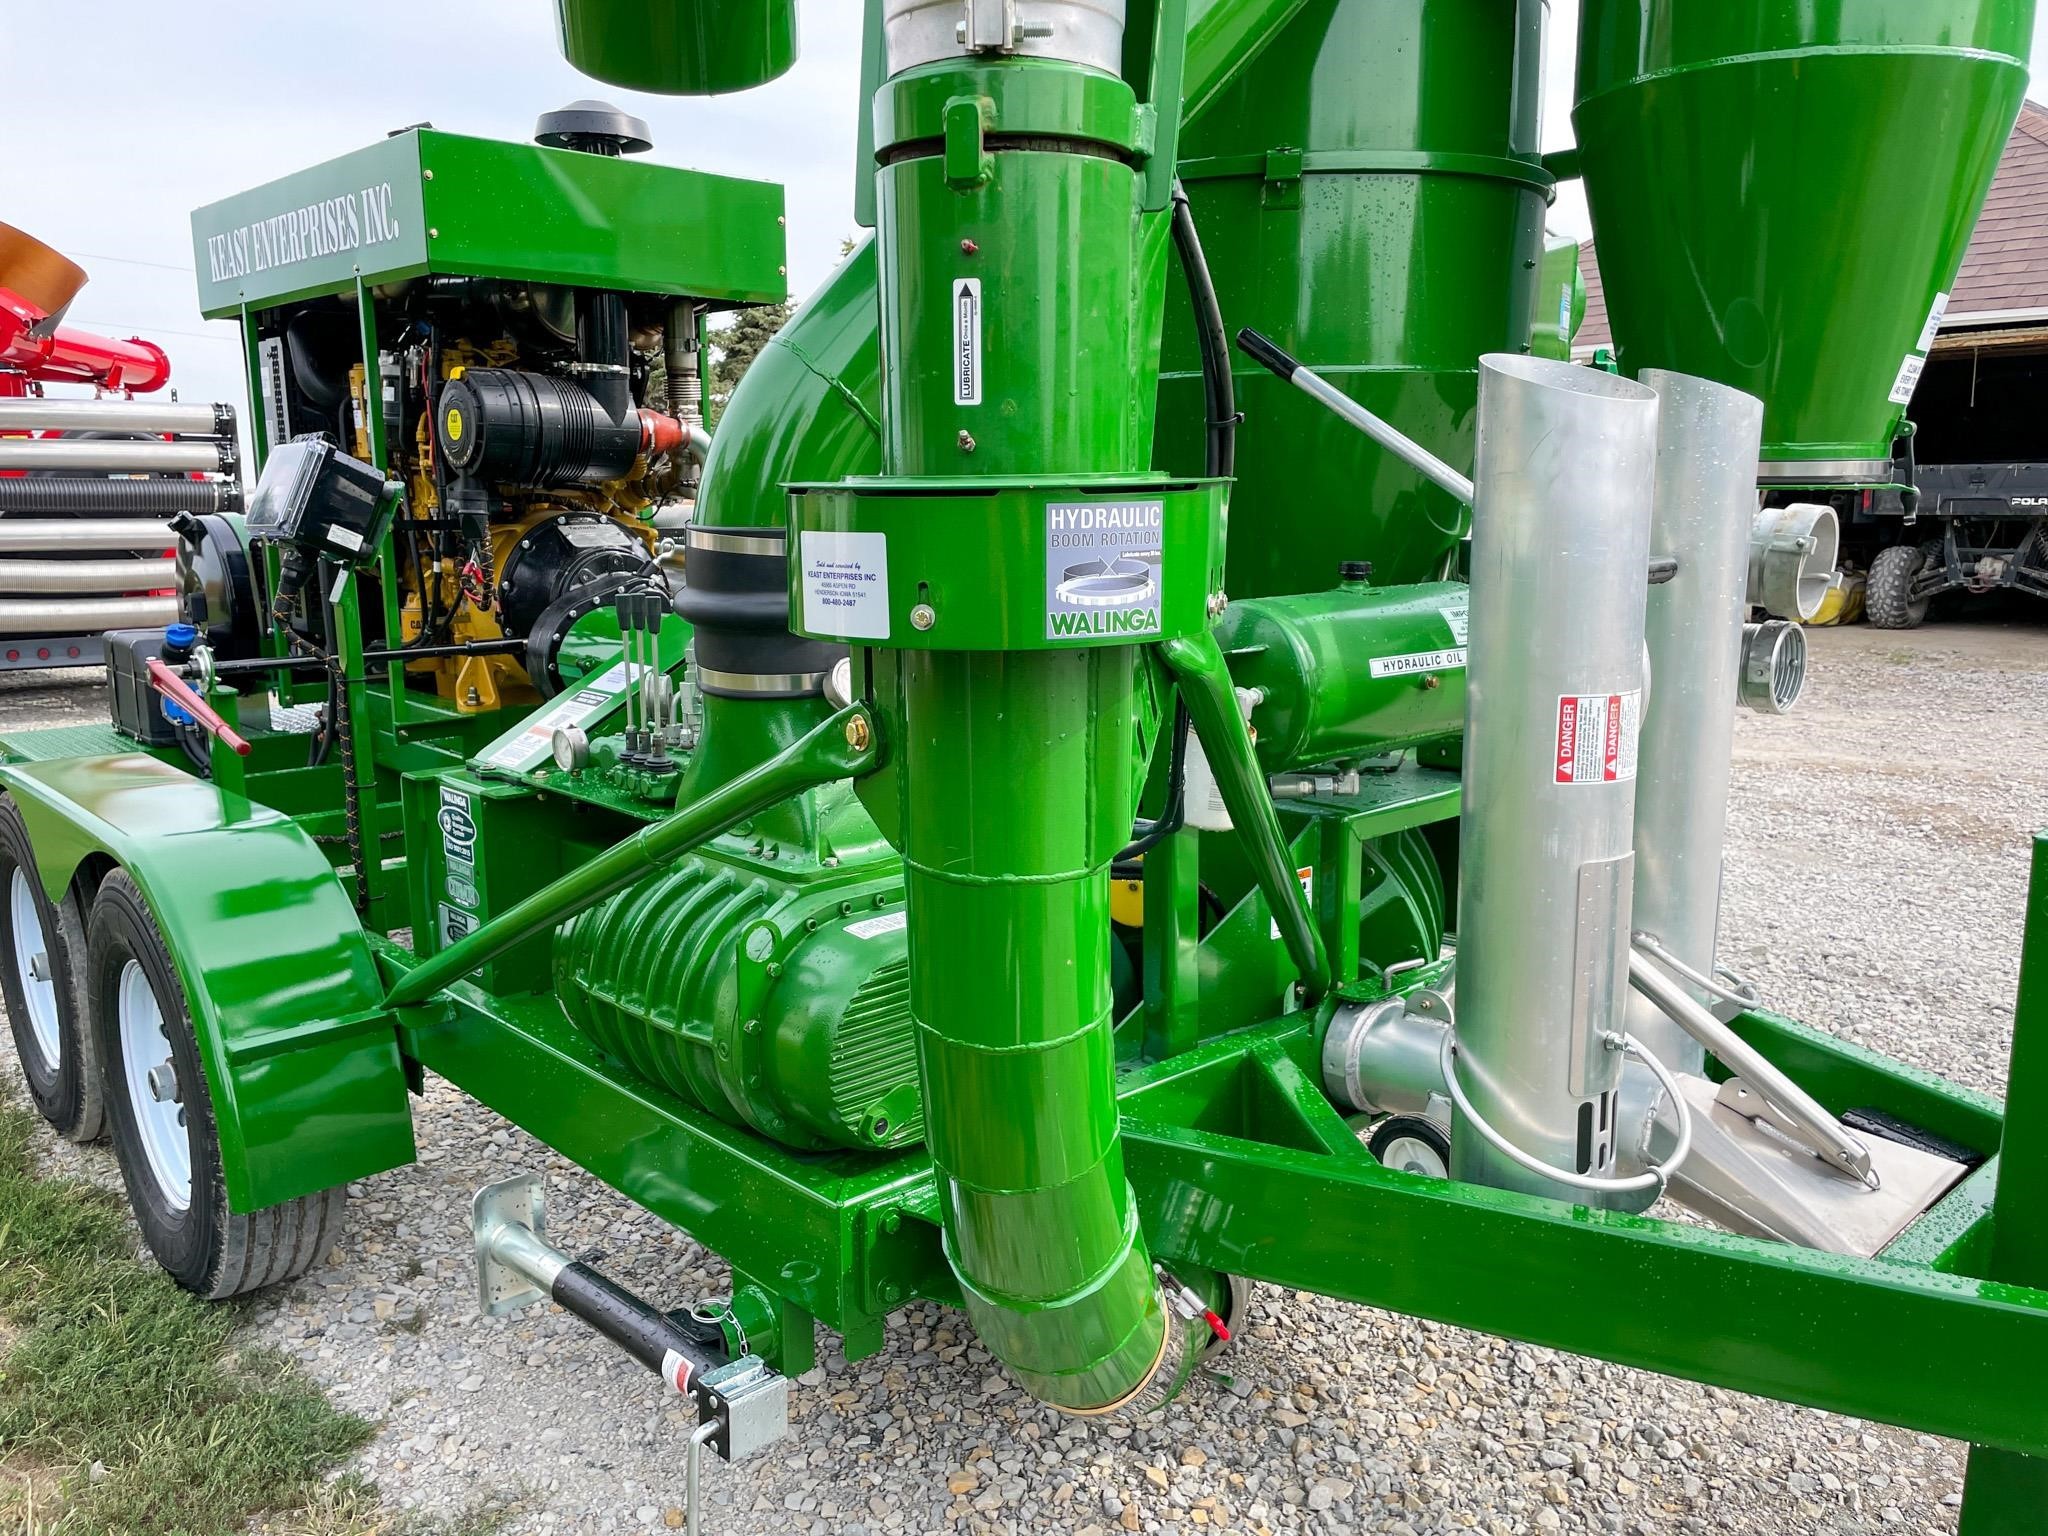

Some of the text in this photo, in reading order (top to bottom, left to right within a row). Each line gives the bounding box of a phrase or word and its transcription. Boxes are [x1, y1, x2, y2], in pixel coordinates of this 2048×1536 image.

[208, 182, 400, 283] KEAST ENTERPRISES INC.
[963, 340, 971, 396] LUBRICATE
[2012, 497, 2048, 505] POLA
[1051, 506, 1160, 530] HYDRAULIC
[1051, 531, 1159, 548] BOOM ROTATION
[808, 570, 876, 582] KEAST ENTERPRISES INC
[1049, 607, 1159, 636] WALINGA
[1382, 652, 1463, 672] HYDRAULIC OIL
[1560, 704, 1575, 758] DANGER
[1607, 702, 1620, 756] DANGER
